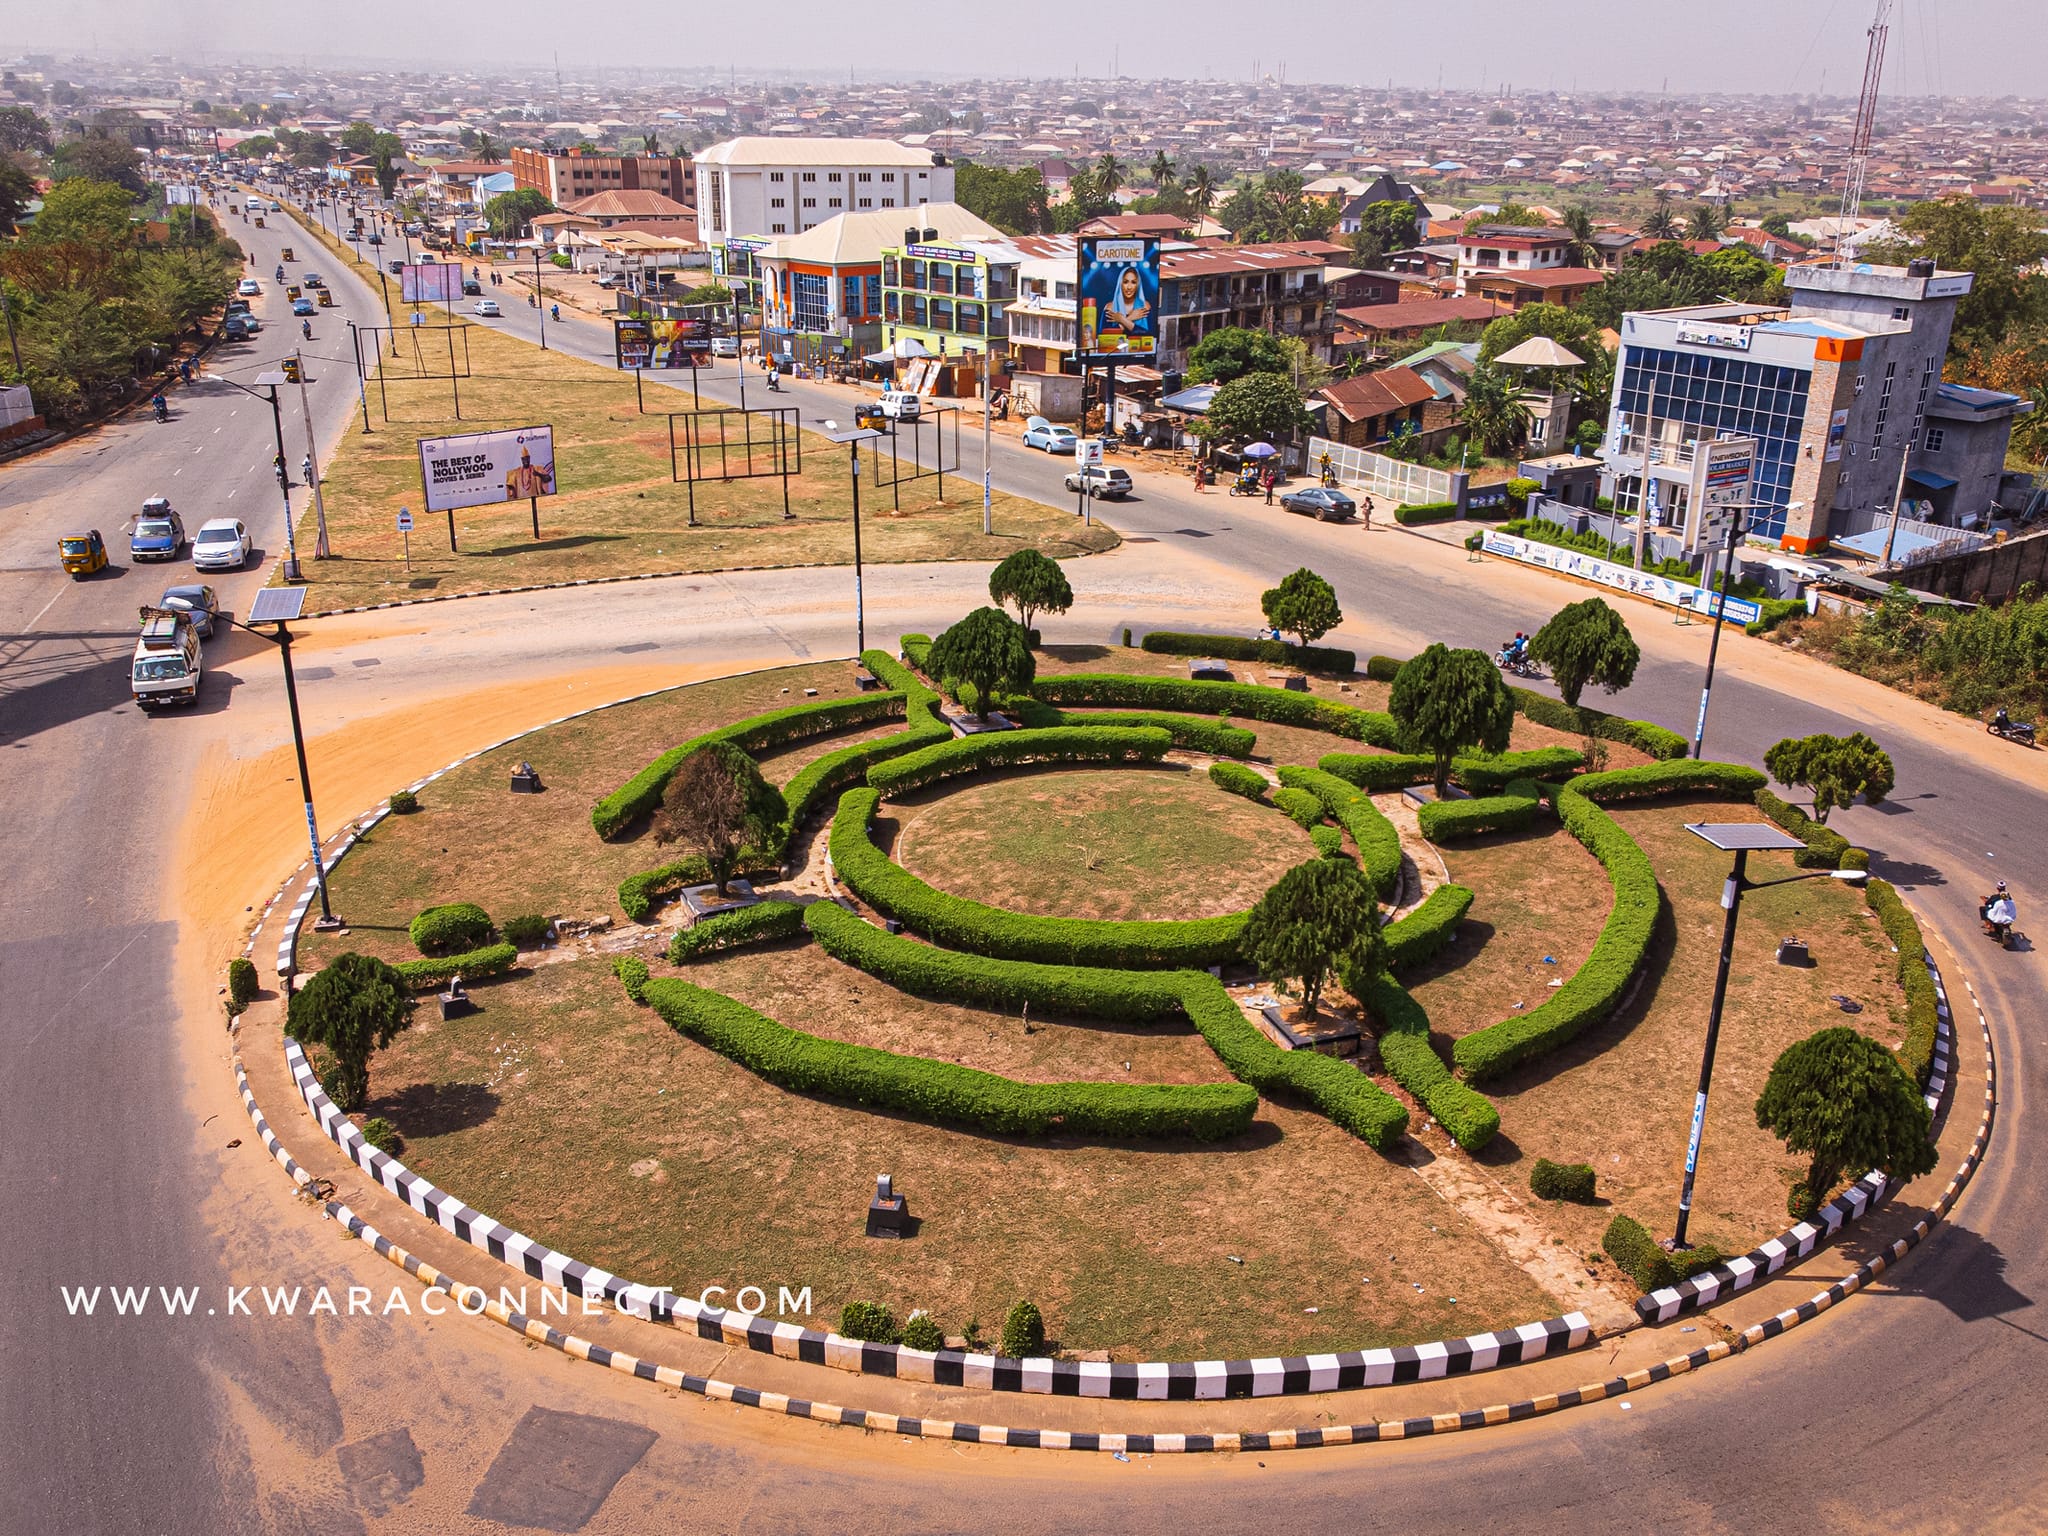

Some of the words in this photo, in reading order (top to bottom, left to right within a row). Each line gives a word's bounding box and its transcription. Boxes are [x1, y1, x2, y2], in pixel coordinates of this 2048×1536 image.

[1098, 248, 1141, 259] CAROTONE
[431, 459, 449, 469] THE
[450, 456, 472, 467] BEST
[474, 454, 486, 463] OF
[433, 462, 494, 478] NOLLYWOOD
[433, 475, 457, 484] MOVIES
[466, 472, 485, 480] SERIES
